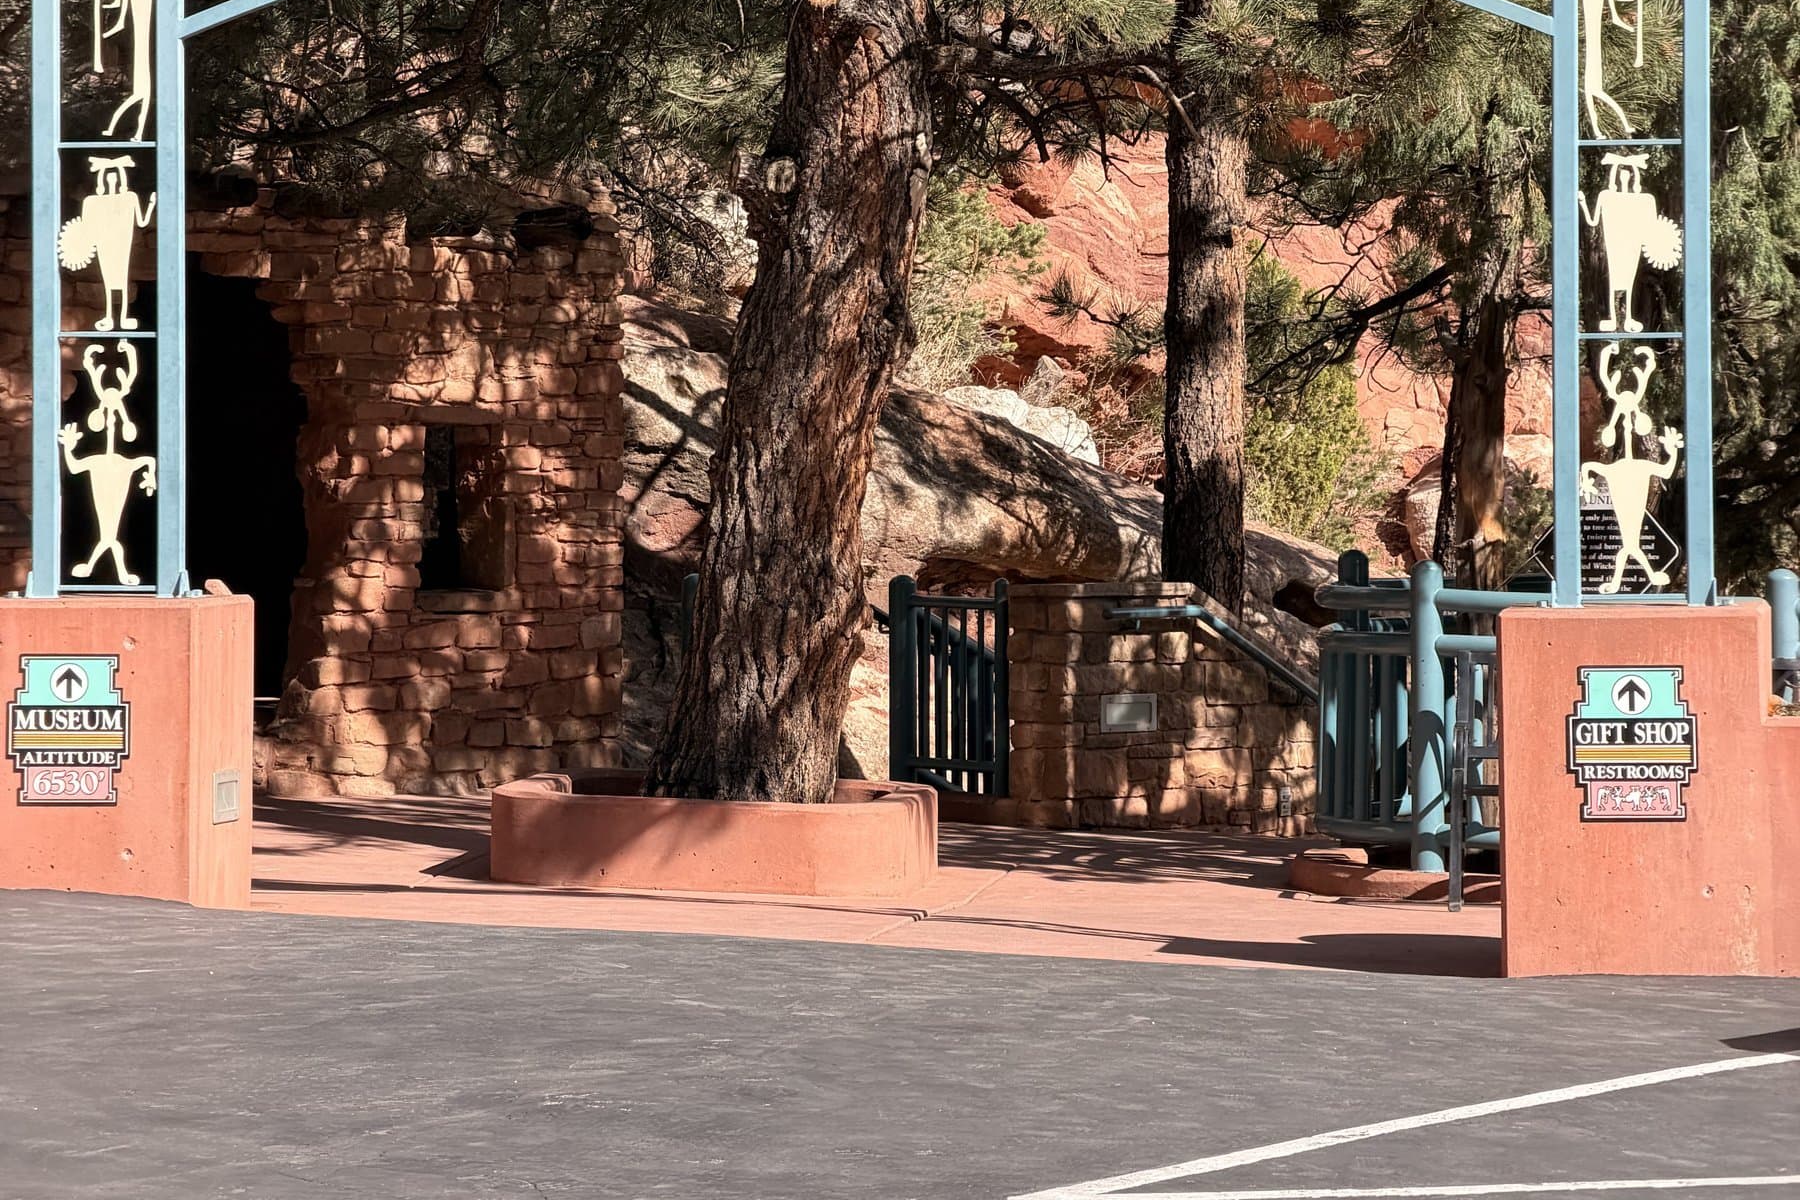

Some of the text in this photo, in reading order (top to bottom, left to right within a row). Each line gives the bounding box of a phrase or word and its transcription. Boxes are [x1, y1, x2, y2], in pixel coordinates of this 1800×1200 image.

[14, 709, 123, 730] MUSEUM
[1576, 722, 1690, 744] GIFT SHOP
[22, 751, 116, 765] ALTITUDE
[1584, 765, 1685, 779] RESTROOMS
[33, 770, 106, 796] 6530'
